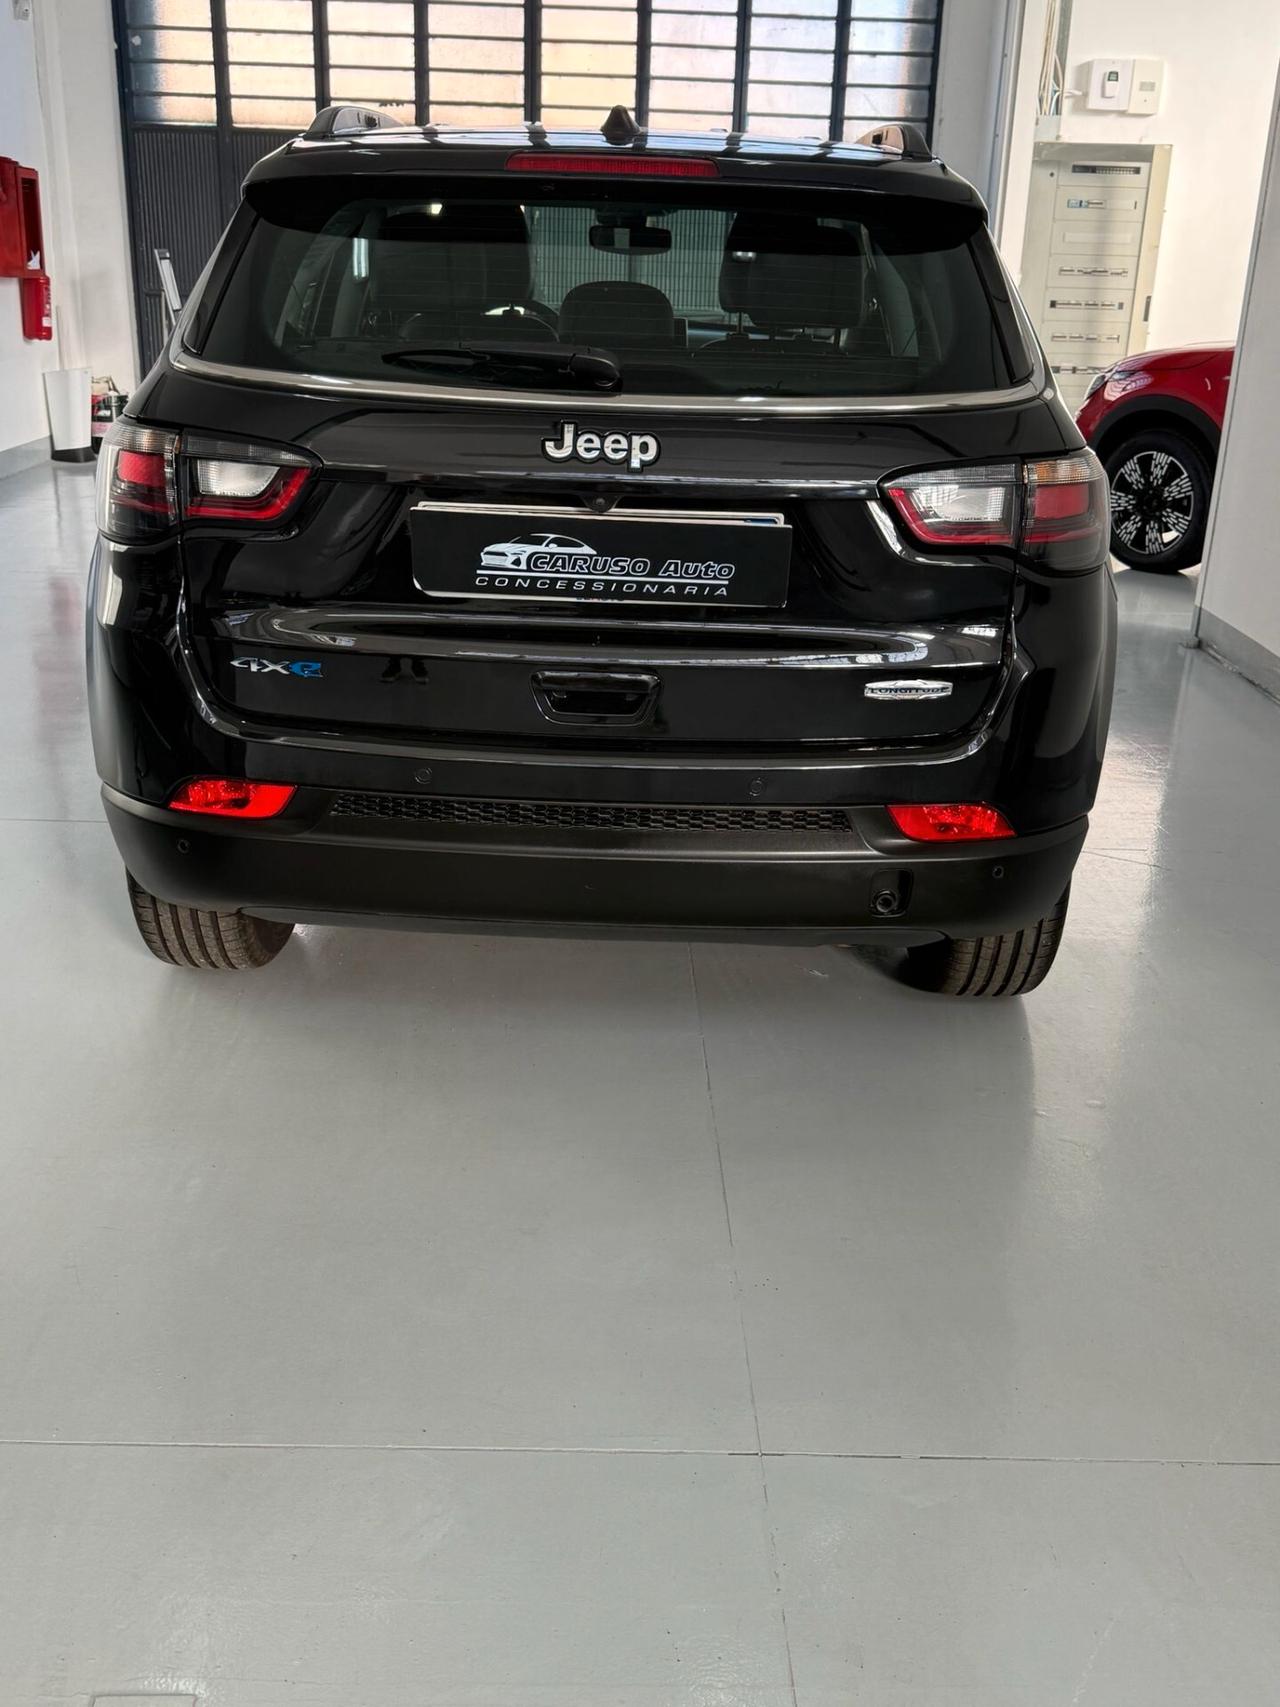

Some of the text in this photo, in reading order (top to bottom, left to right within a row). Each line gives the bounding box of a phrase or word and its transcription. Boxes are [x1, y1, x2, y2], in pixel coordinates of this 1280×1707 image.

[543, 421, 659, 470] Jeep
[529, 552, 736, 579] CARUSO Auto
[474, 575, 729, 597] CONCESSIONARIA
